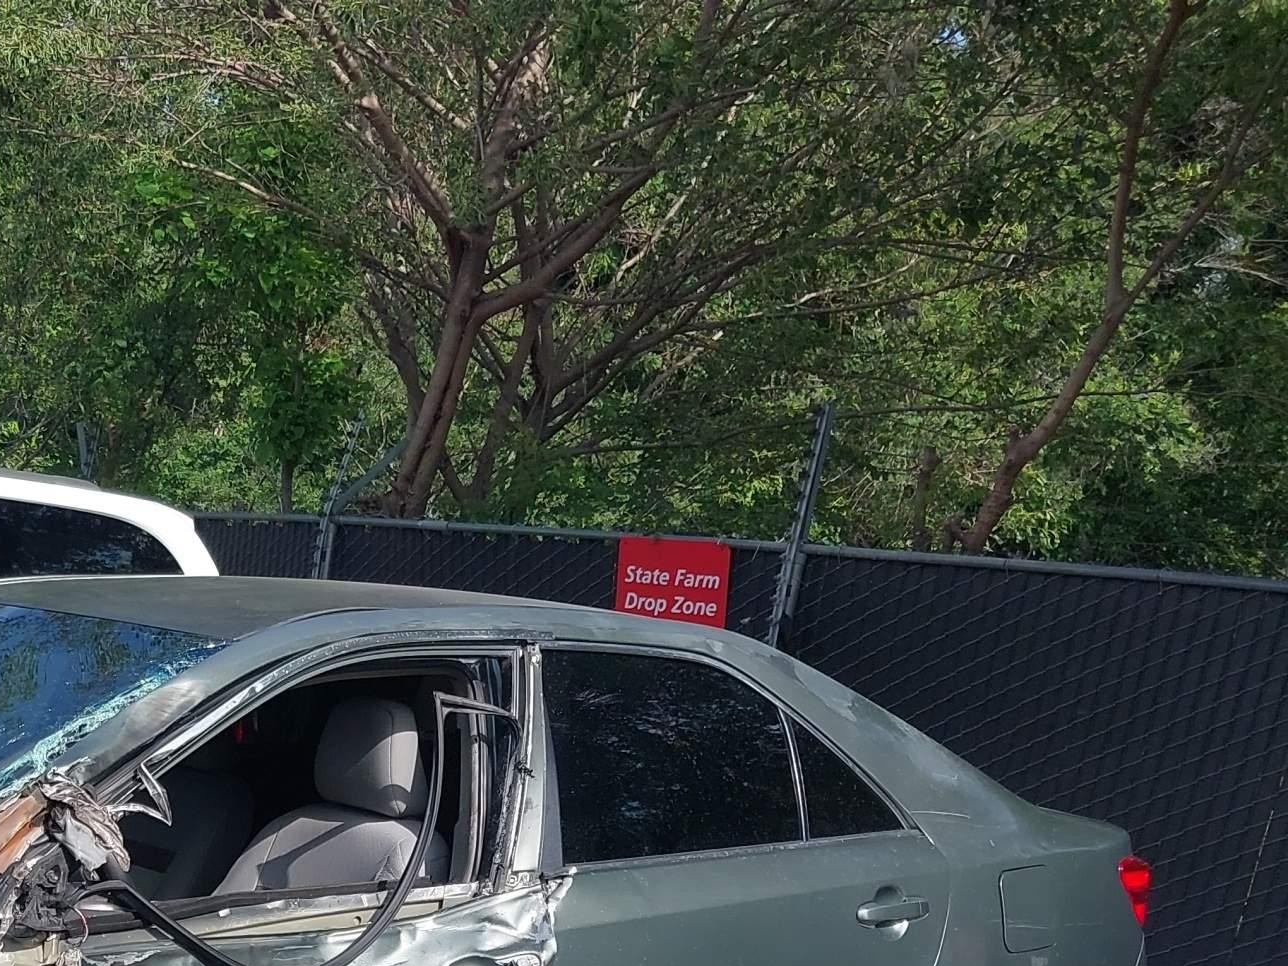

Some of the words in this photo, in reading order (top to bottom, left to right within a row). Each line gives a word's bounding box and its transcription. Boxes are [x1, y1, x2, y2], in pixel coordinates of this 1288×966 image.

[624, 565, 670, 586] State
[674, 568, 721, 590] Farm
[624, 592, 668, 617] Drop
[670, 596, 718, 617] Zone
